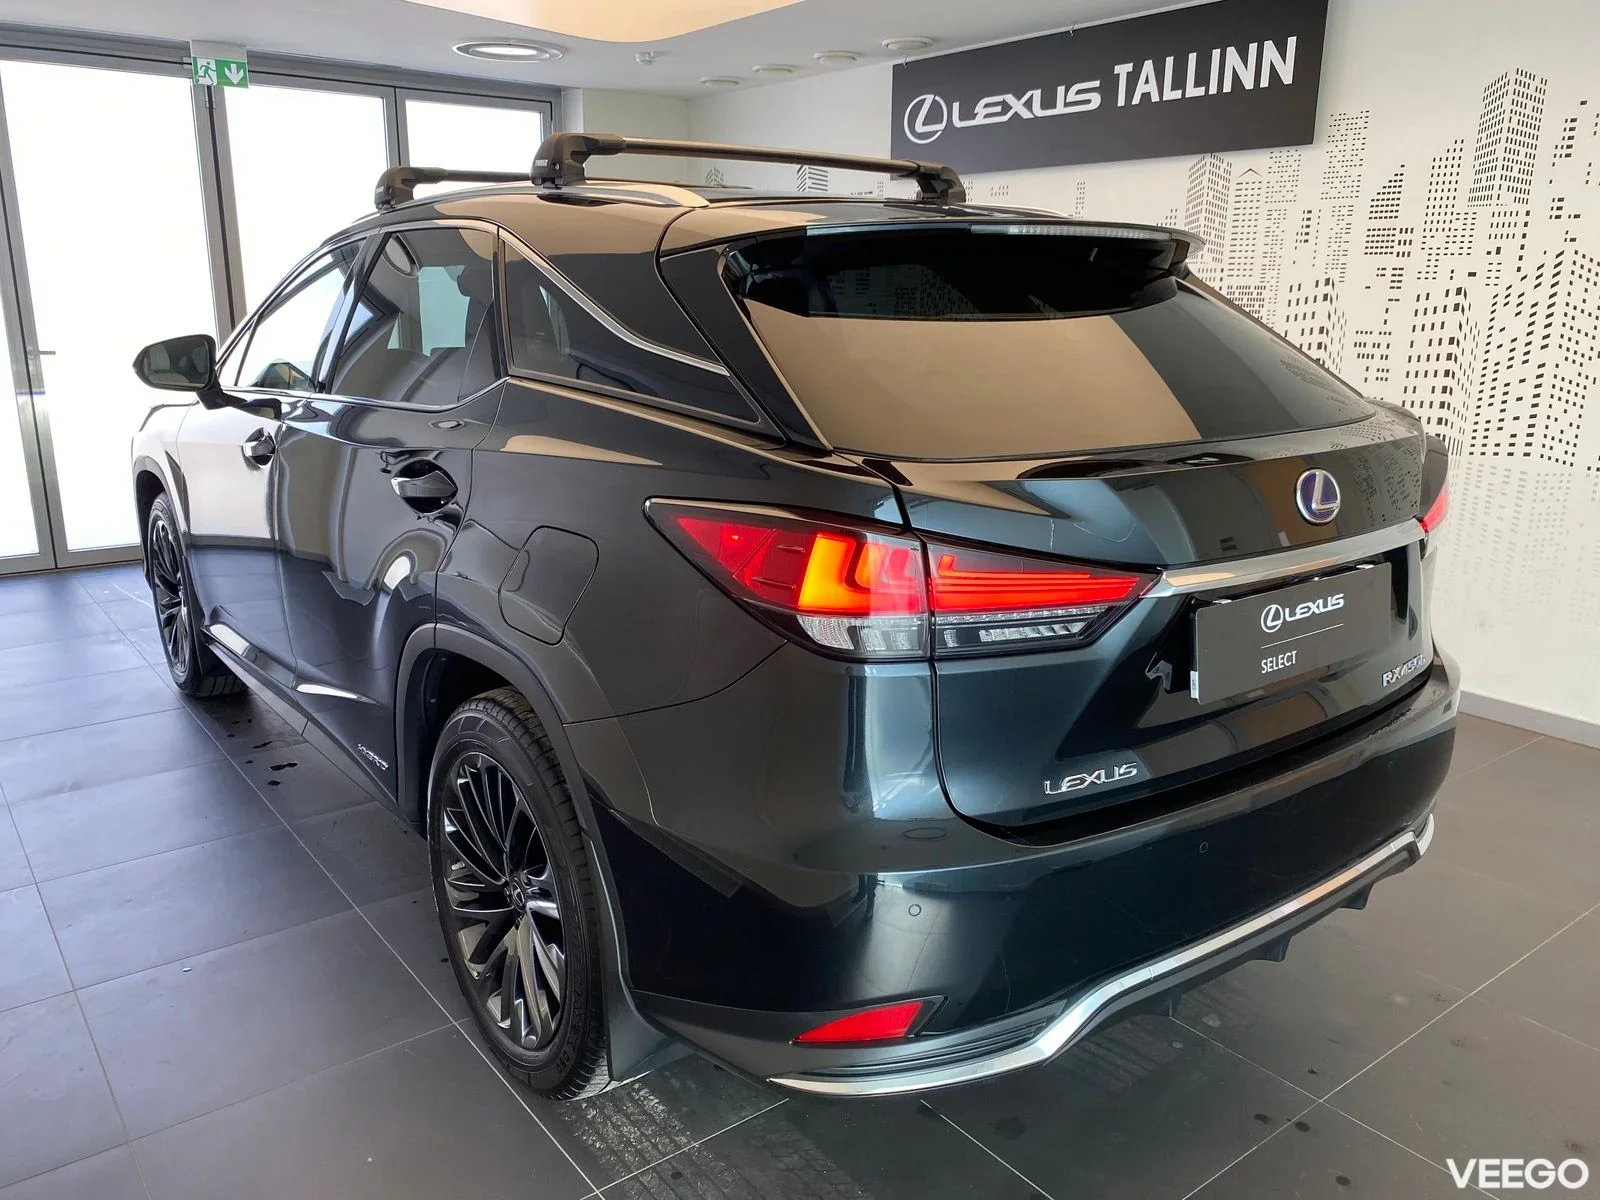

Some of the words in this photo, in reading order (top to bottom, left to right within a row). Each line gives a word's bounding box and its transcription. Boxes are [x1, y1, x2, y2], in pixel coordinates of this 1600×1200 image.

[952, 80, 1101, 128] LEXUS
[1113, 35, 1297, 107] TALLINN
[1284, 593, 1344, 622] LEXUS
[1261, 650, 1297, 674] SELECT
[1043, 762, 1138, 795] LEXUS
